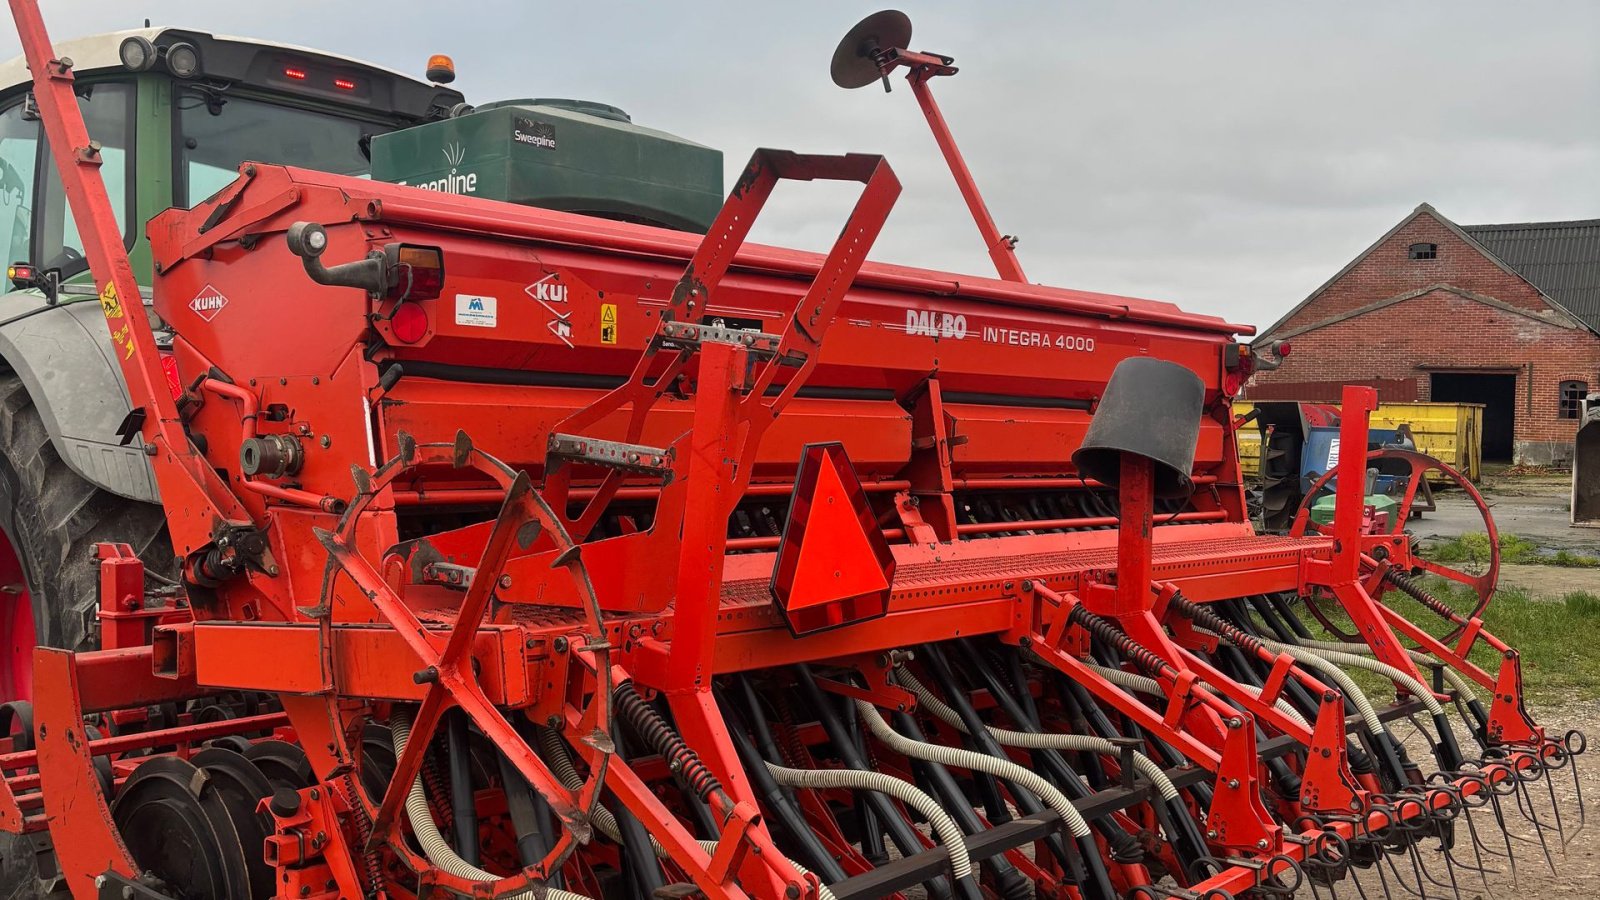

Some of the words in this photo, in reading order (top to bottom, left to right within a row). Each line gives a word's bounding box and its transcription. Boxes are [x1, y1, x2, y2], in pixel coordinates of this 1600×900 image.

[514, 130, 556, 148] Sweepline
[194, 295, 223, 311] KUHN
[983, 326, 1052, 348] INTEGRA
[1055, 335, 1096, 352] 4000
